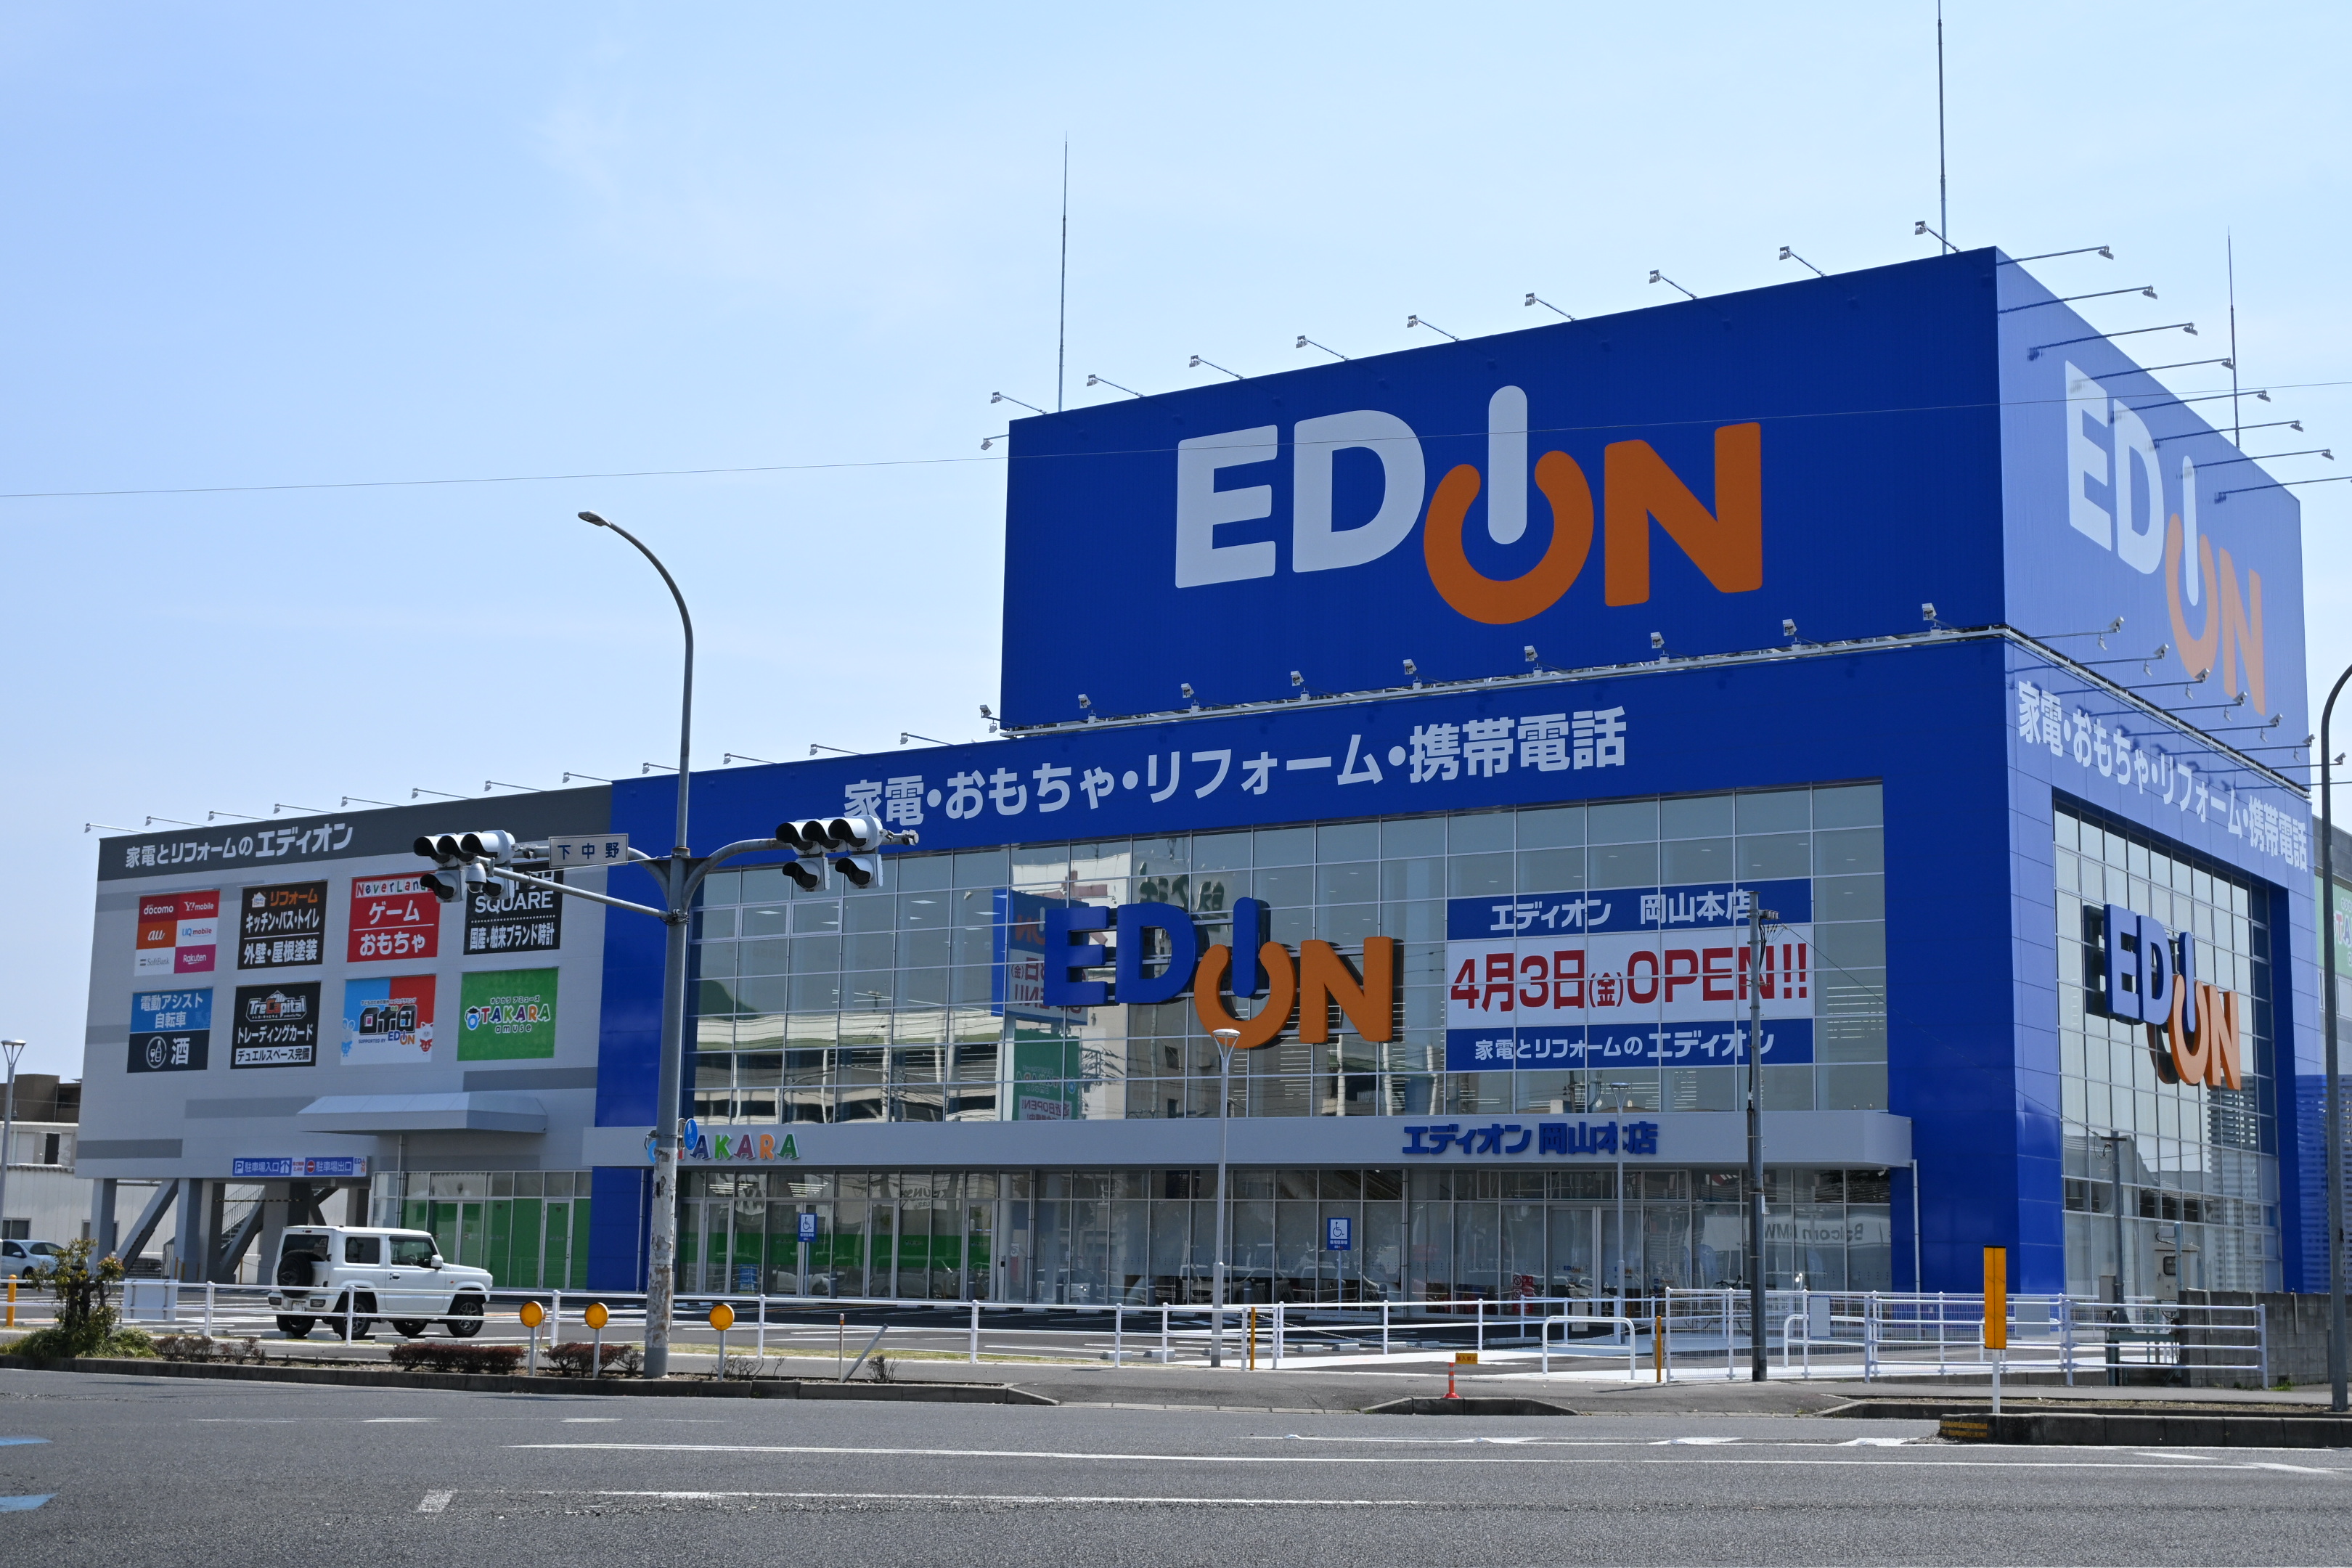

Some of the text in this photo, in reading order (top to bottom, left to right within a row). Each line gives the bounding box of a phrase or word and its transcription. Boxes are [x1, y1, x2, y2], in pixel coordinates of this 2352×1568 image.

[1175, 385, 1763, 624] EDION
[2065, 360, 2266, 716] EDION
[126, 823, 353, 868] 家電とリフォームのエディオン
[557, 842, 619, 860] 下中野
[270, 888, 319, 907] リフォーム
[475, 891, 554, 914] SQUARE
[144, 905, 173, 915] docomo
[245, 907, 319, 934] キッチン・バス・トイレ
[369, 899, 420, 925] ゲーム
[1490, 890, 1751, 931] エディオン 岡山本店
[147, 930, 166, 941] au
[360, 931, 425, 956] おもちゃ
[147, 957, 170, 966] SoftBank
[183, 954, 207, 963] Rakuten
[244, 939, 318, 965] 外壁・屋根塗装
[1043, 897, 1394, 1049] EDION
[140, 992, 203, 1011] 電動アシスト
[2104, 903, 2242, 1090] EDION
[155, 1011, 187, 1029] 自転車
[495, 1024, 532, 1034] amuse
[237, 1024, 314, 1044] トレーディングカード
[171, 1037, 191, 1066] 酒
[237, 1048, 310, 1063] デュエルスペース完備
[1402, 1121, 1659, 1155] エディオン 岡山本店
[244, 1161, 279, 1173] 駐車場入口
[316, 1161, 352, 1172] 駐車場出口
